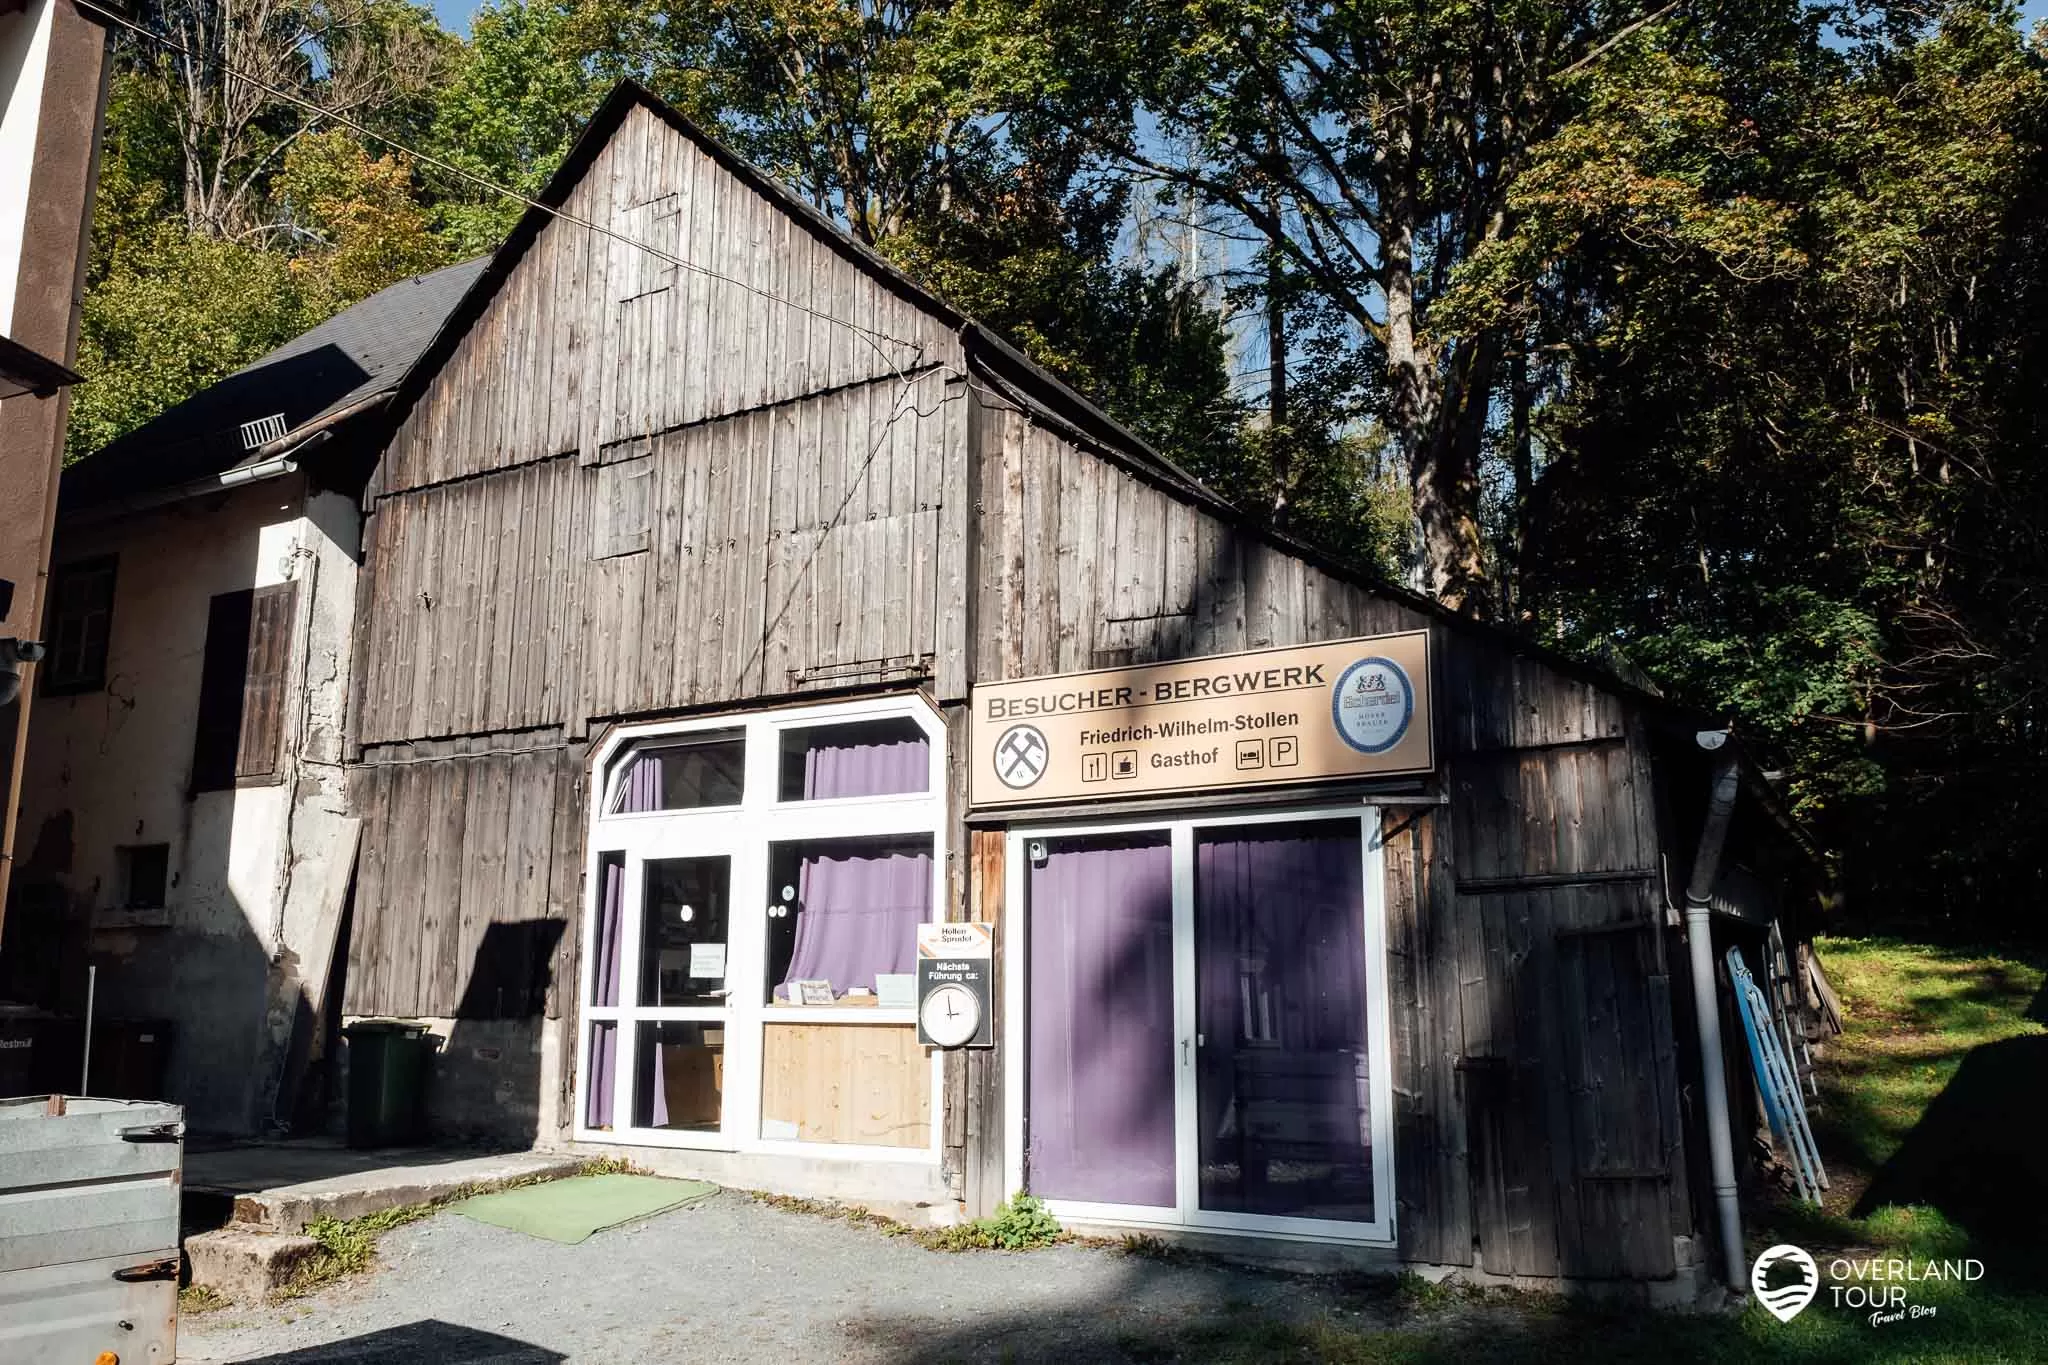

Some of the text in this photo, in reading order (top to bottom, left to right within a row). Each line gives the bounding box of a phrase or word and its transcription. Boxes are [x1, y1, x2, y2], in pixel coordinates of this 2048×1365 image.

[988, 687, 1132, 719] BESUCHER
[1155, 663, 1325, 701] BERGWERK
[1080, 711, 1298, 746] Friedrich-Wilhelm-Stollen
[1151, 741, 1292, 769] Gasthof P
[928, 971, 979, 982] Führung ca:
[936, 962, 970, 971] Nächste
